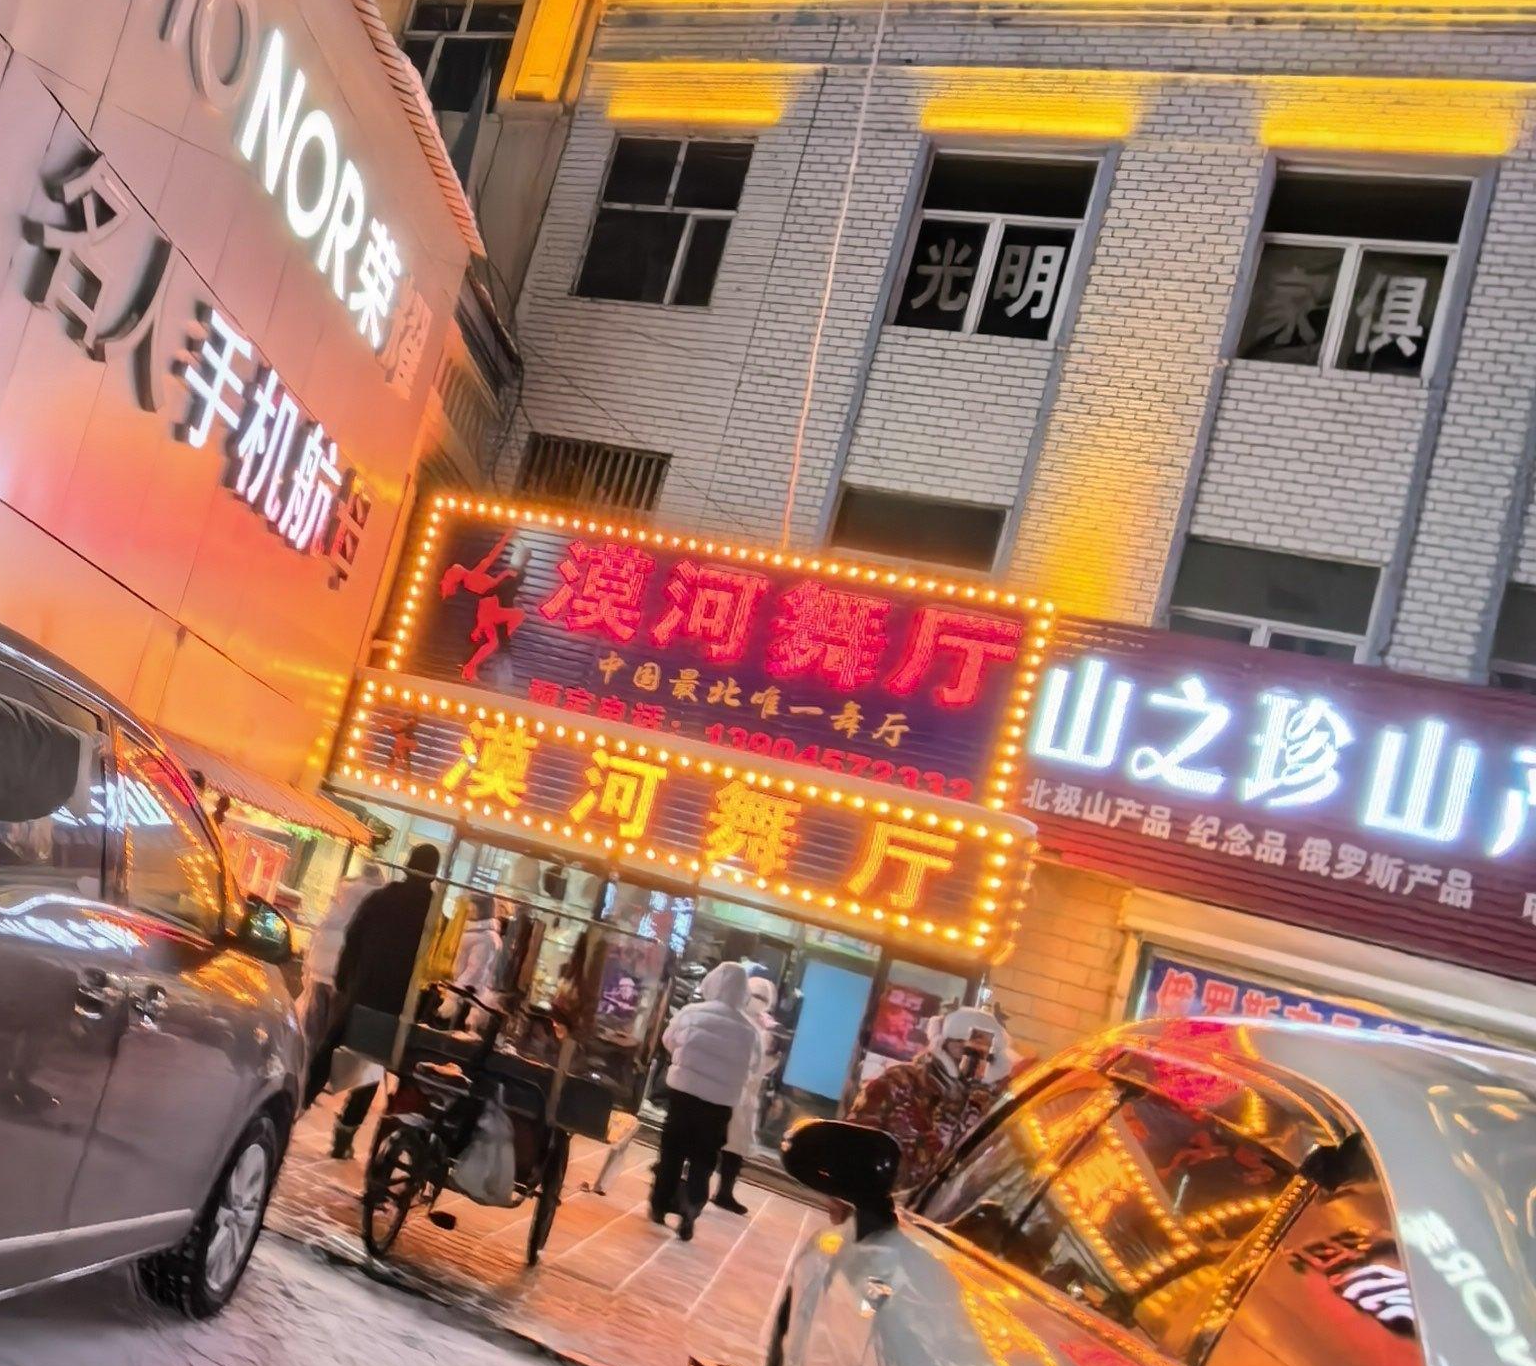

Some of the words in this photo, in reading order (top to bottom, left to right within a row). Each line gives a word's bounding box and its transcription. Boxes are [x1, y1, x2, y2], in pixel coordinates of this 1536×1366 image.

[911, 238, 1066, 319] 光明
[1263, 267, 1428, 357] 家俱
[539, 540, 1023, 708] 漠河舞厅
[596, 651, 911, 747] 中国最北唯一舞厅
[442, 719, 959, 909] 漠河舞厅
[1022, 778, 1171, 840] 北极山产品
[1185, 814, 1287, 867] 纪念品
[1298, 837, 1474, 910] 俄罗斯产品
